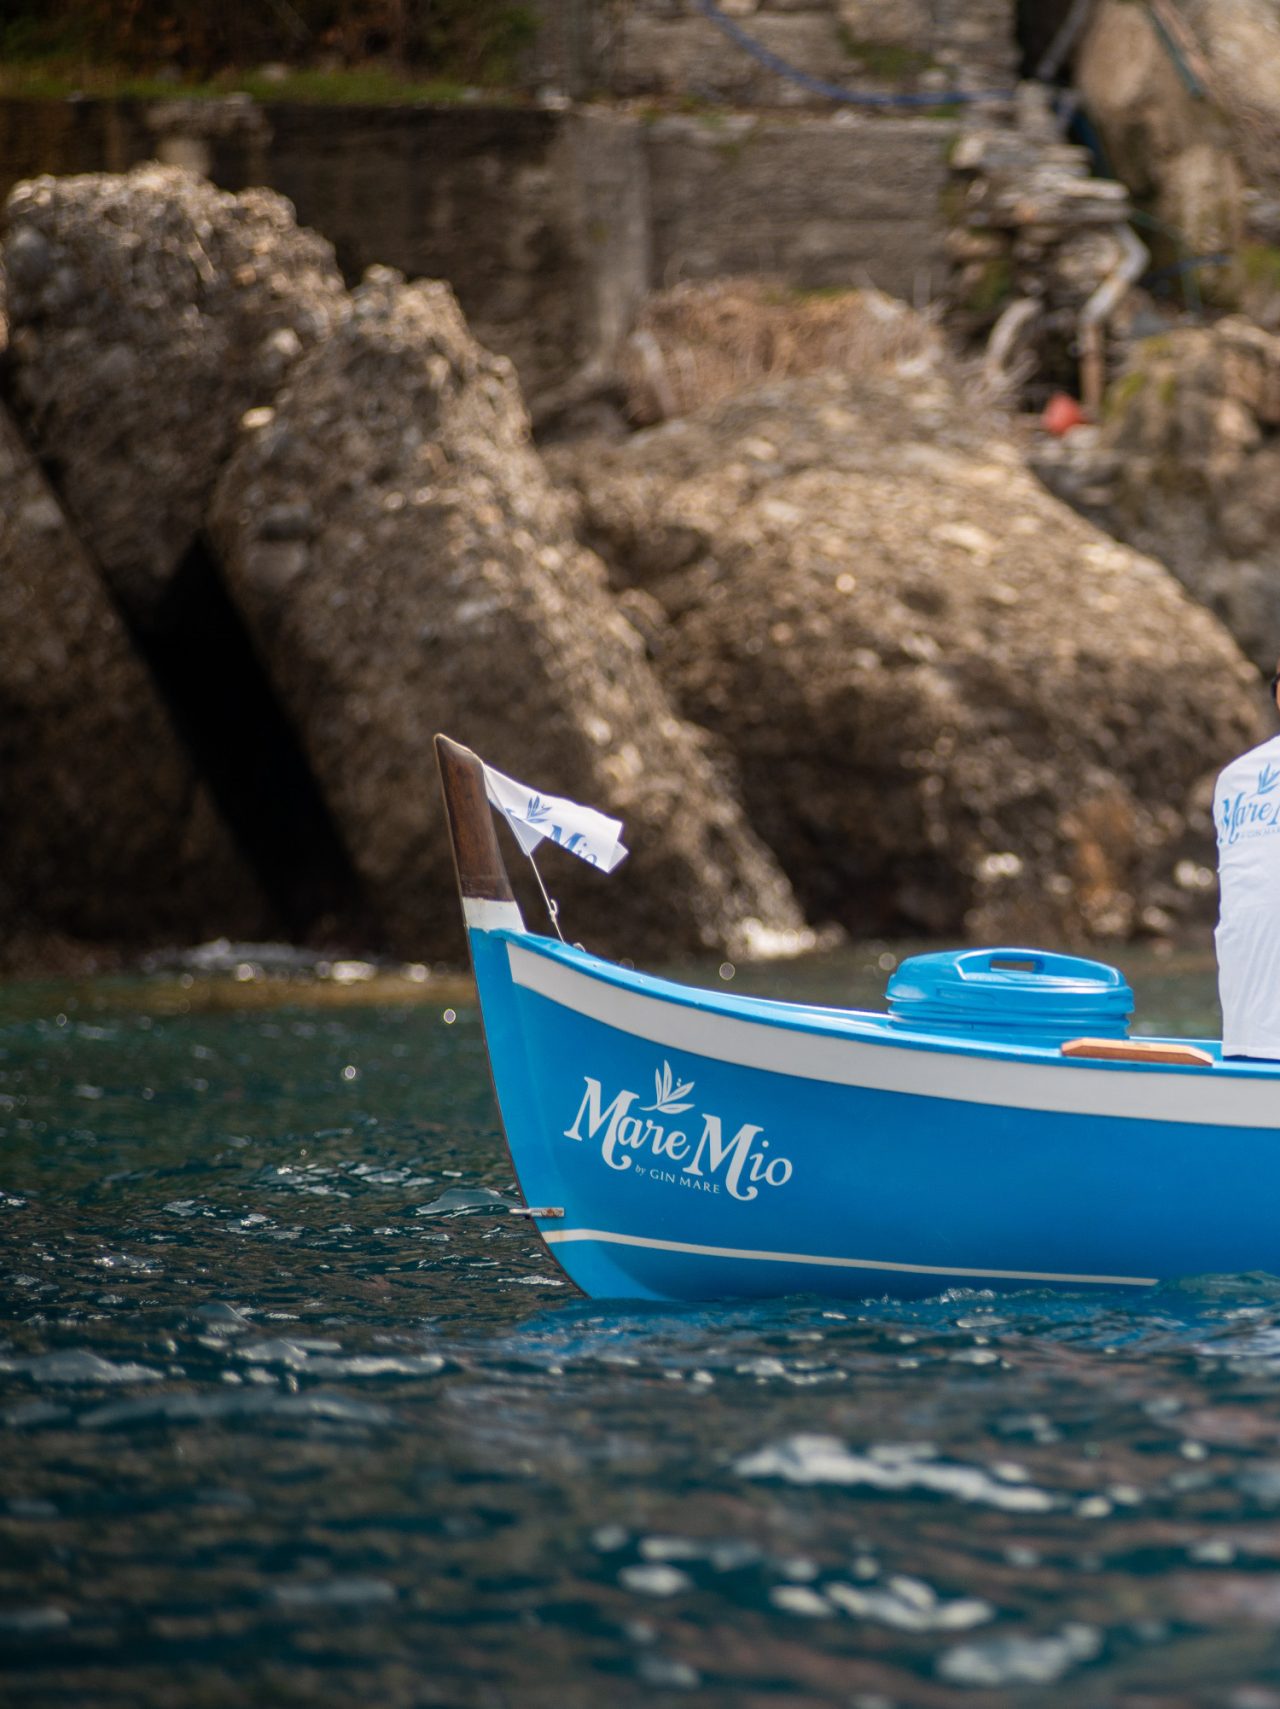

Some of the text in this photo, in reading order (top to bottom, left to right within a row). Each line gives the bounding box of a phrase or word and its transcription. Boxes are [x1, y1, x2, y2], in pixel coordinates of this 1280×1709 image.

[1219, 792, 1273, 844] Mare
[563, 1076, 793, 1201] Mare Mio
[635, 1164, 720, 1194] by GIN MARE
